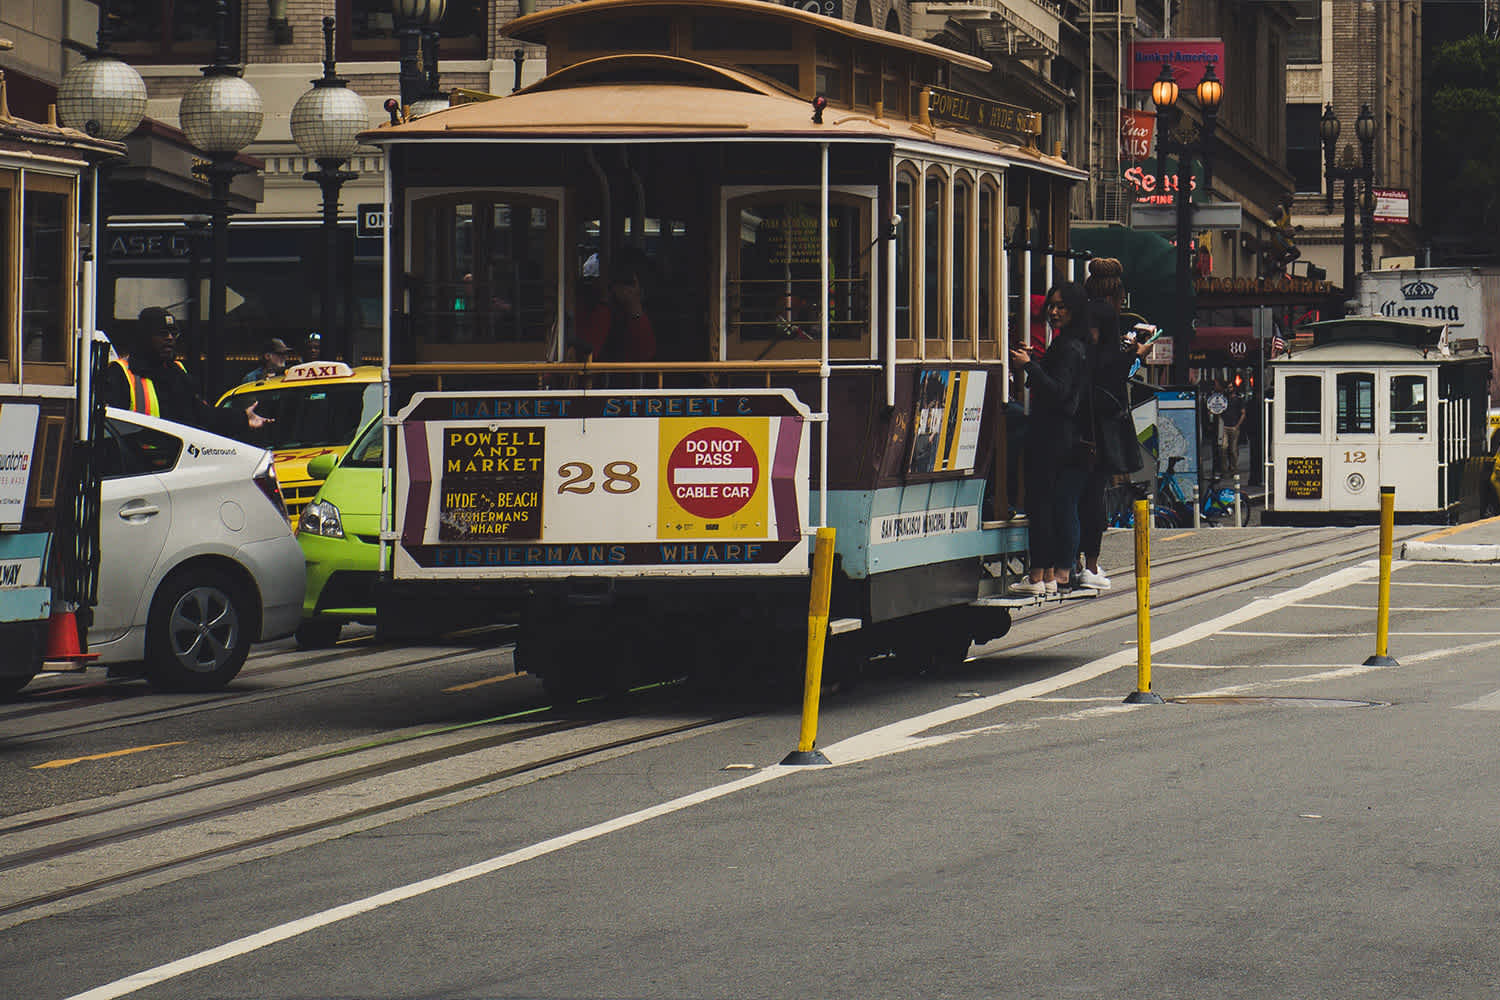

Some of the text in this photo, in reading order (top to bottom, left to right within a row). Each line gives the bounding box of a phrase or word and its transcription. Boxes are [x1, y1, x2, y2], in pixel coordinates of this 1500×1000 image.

[1135, 51, 1219, 63] Bank of America
[932, 92, 970, 121] POWELL
[1150, 195, 1174, 205] FINE
[1380, 300, 1459, 321] Corona
[1230, 341, 1246, 354] 80
[294, 366, 337, 378] TAXI
[451, 399, 571, 418] MARKET
[602, 396, 723, 417] STREET
[450, 432, 542, 448] POWELL
[686, 440, 742, 453] DO NOT
[201, 446, 237, 457] Getaround
[473, 447, 518, 457] AND
[1344, 451, 1367, 464] 12
[447, 458, 542, 473] MARKET
[695, 453, 733, 466] PASS
[557, 460, 641, 495] 28
[676, 486, 750, 498] CABLE CAR
[446, 493, 477, 508] HYDE
[497, 492, 538, 508] BEACH
[470, 523, 510, 534] WHARF
[881, 519, 895, 539] SAN
[435, 543, 762, 565] FISHERMANS WHARF
